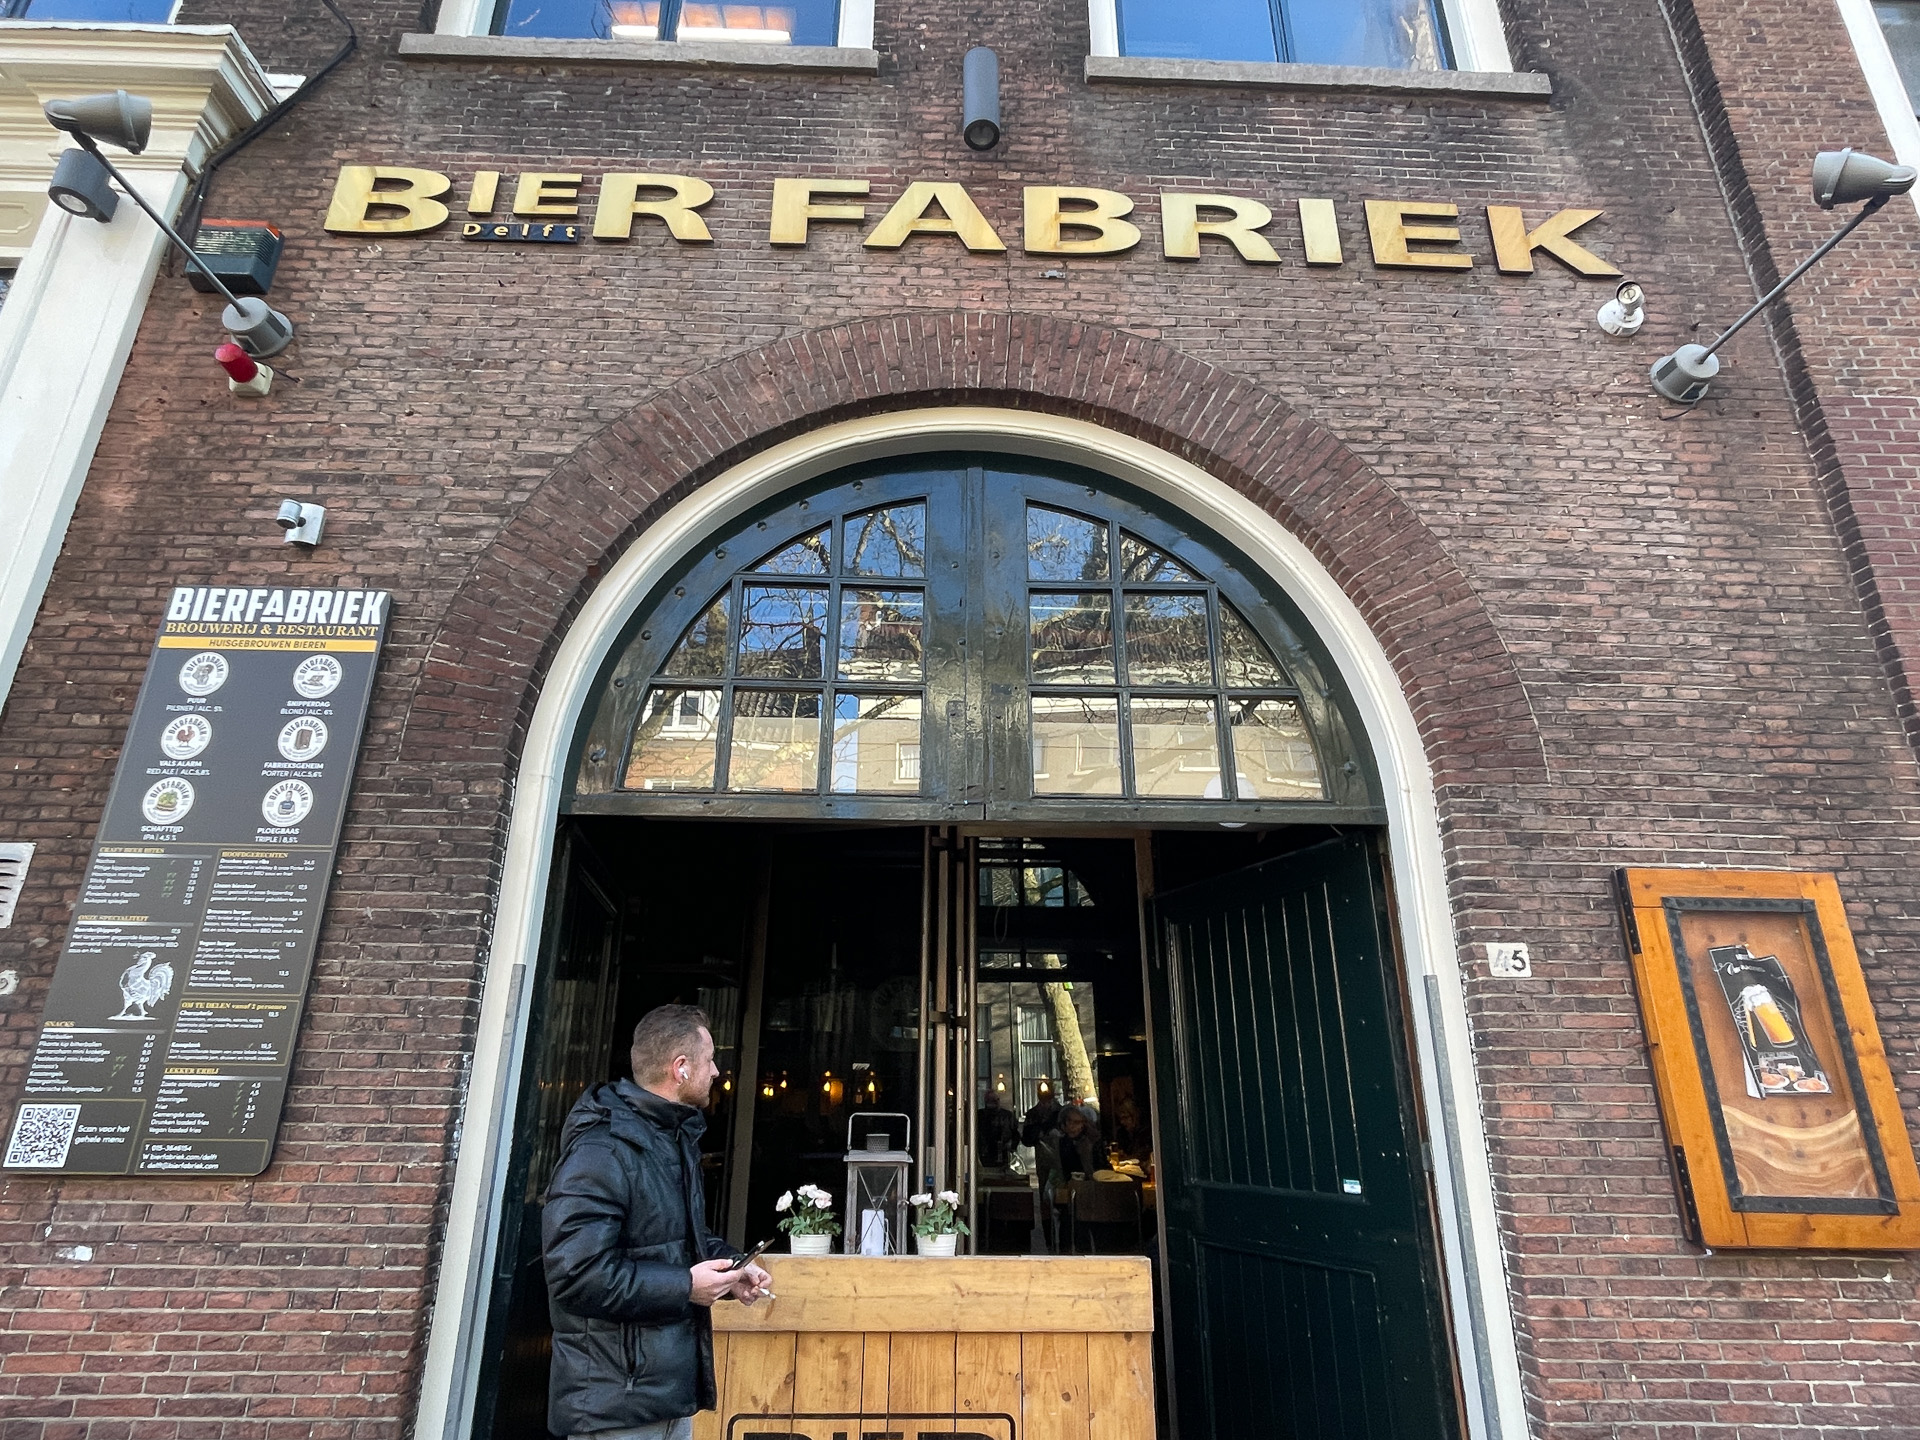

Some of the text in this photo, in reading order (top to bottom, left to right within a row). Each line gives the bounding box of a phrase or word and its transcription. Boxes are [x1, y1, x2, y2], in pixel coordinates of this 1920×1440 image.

[324, 165, 1621, 278] BIER FABRIEK
[462, 222, 578, 240] Delft
[167, 587, 388, 625] BIERFABRIEK
[165, 623, 378, 637] BROUWERIJ & RESTAURANT
[209, 639, 326, 649] HUISGEBROUWEN BIEREN
[78, 1125, 97, 1133] Scan
[75, 1136, 101, 1145] gehele
